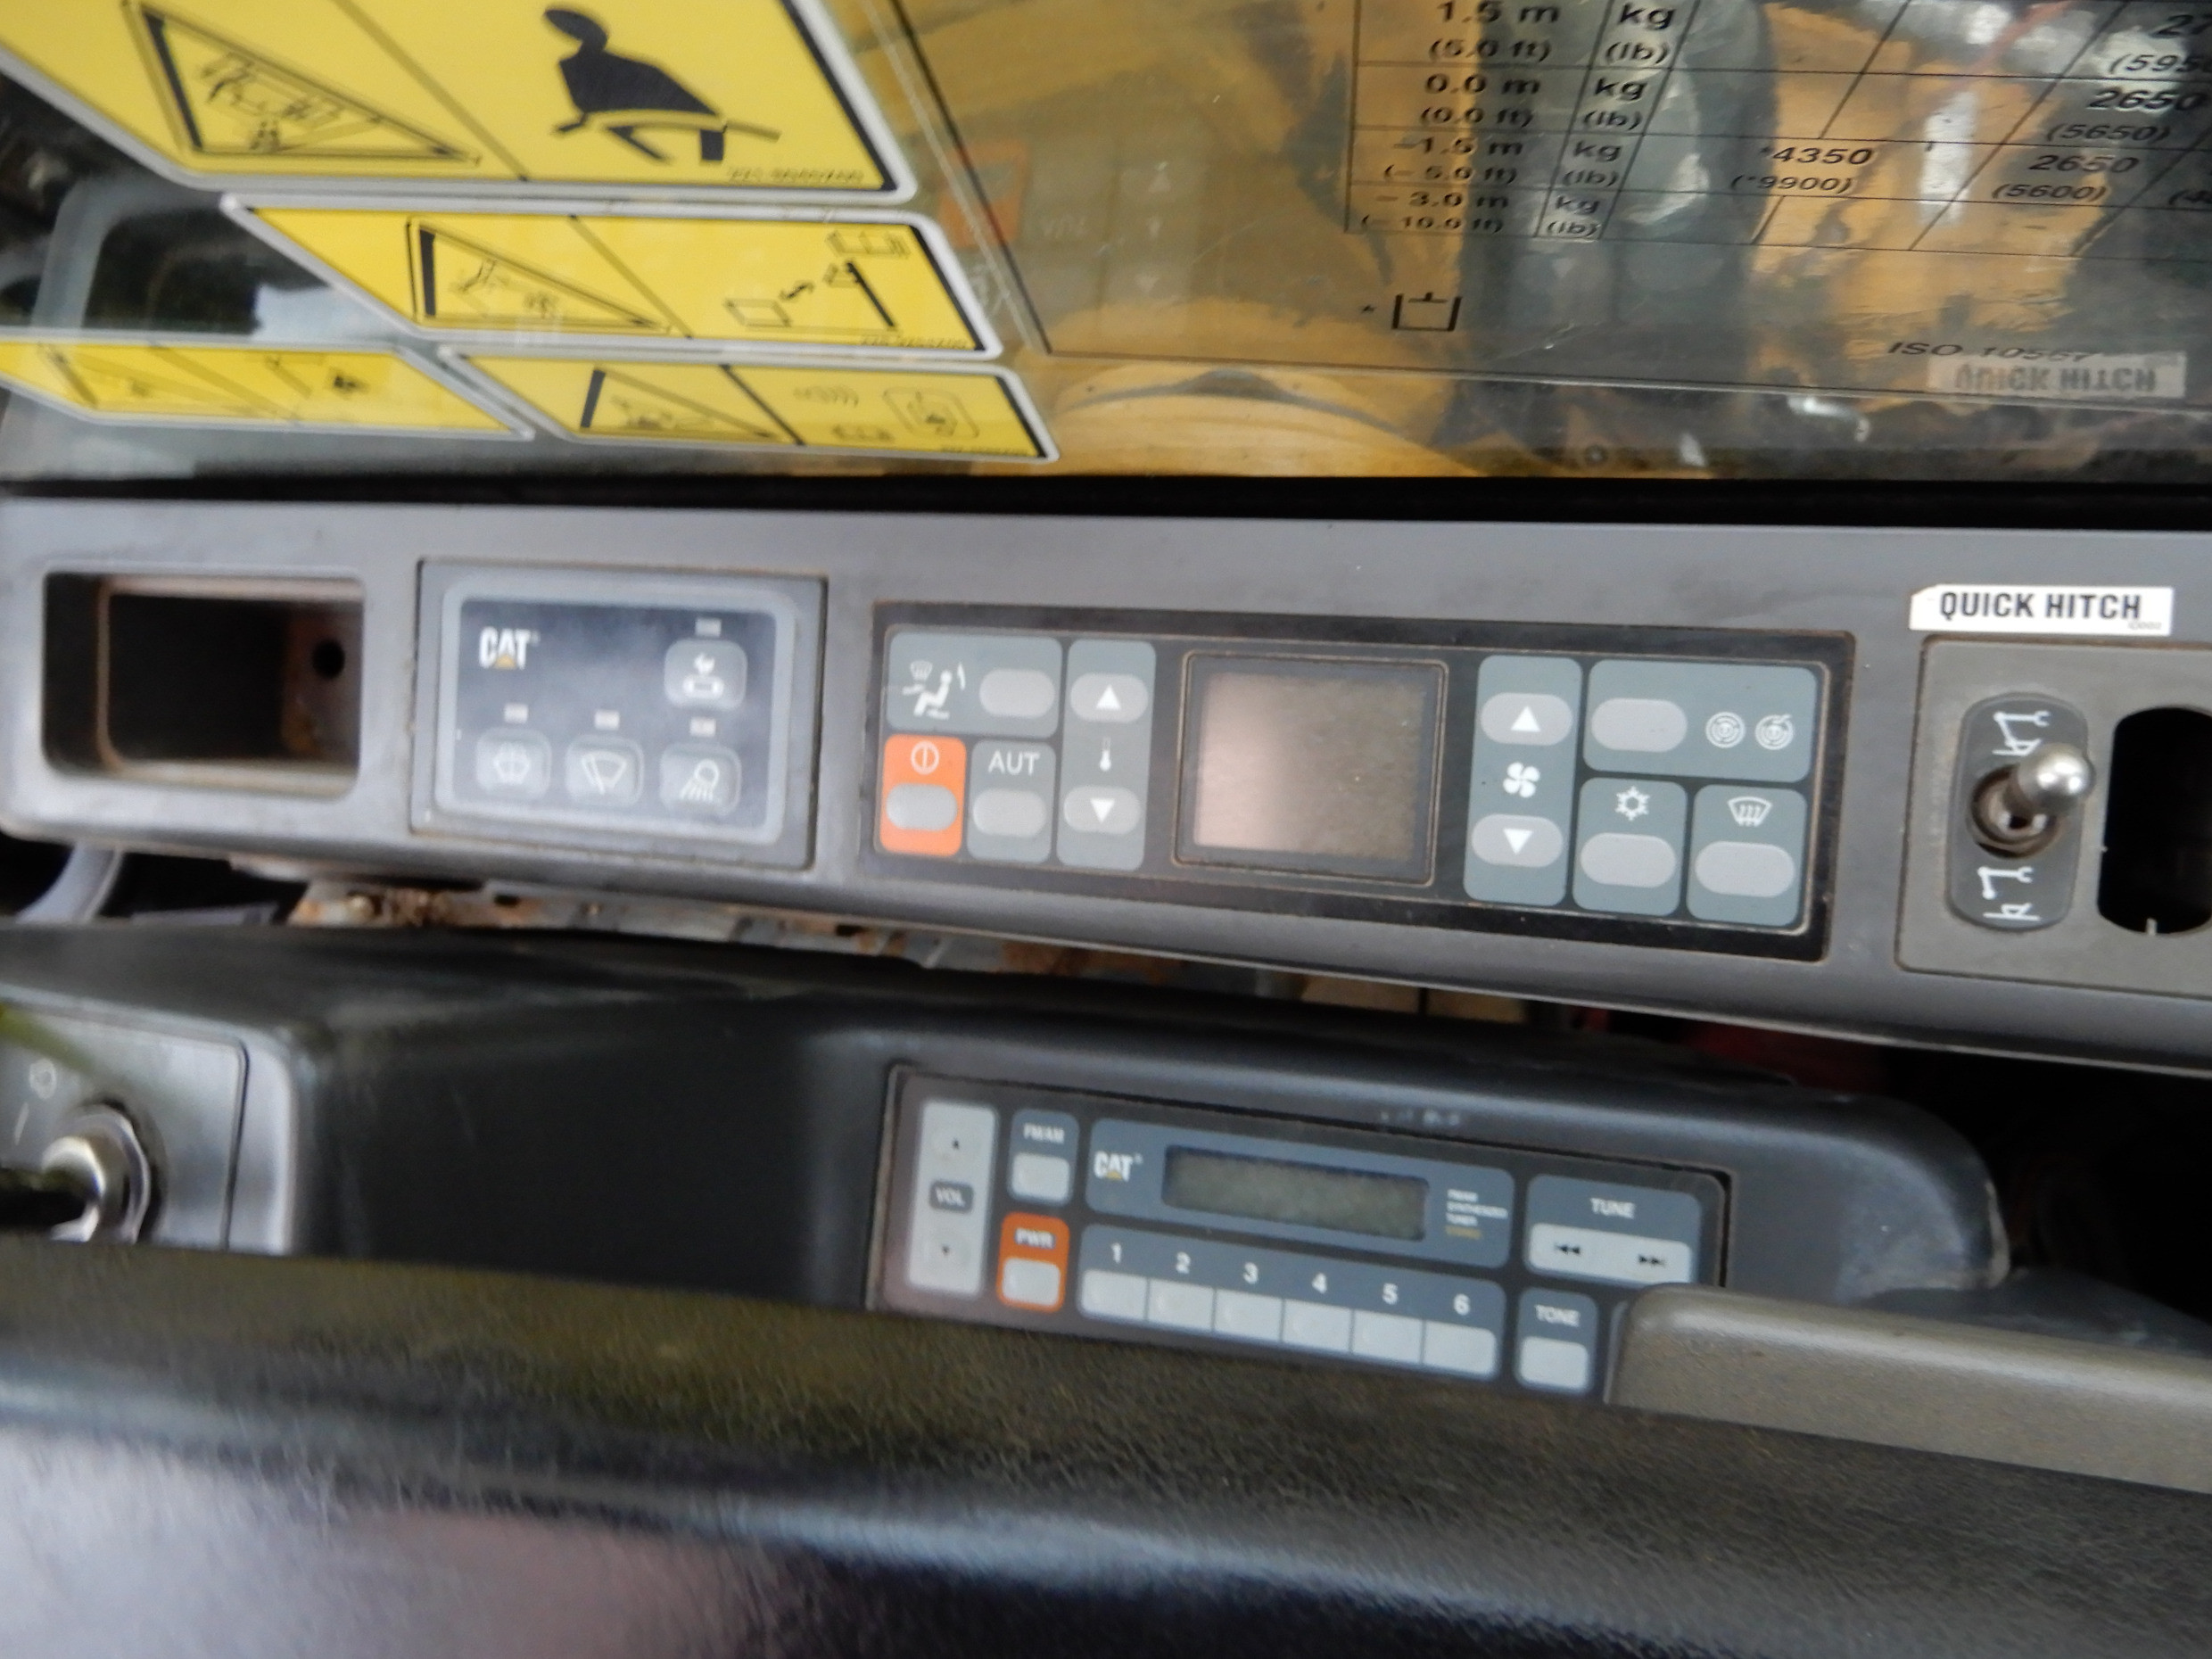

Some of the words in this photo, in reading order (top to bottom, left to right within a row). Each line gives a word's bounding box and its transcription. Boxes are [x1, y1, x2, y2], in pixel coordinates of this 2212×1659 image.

[1518, 5, 1561, 23] m
[1619, 3, 1676, 29] kg
[1605, 41, 1670, 64] (lb)
[1500, 78, 1542, 95] m
[1594, 77, 1648, 102] kg
[2088, 87, 2211, 111] 2650
[1582, 110, 1643, 132] (lb)
[2045, 122, 2172, 144] (5650)
[1489, 141, 1524, 156] m
[1573, 140, 1623, 163] kg
[2027, 153, 2140, 175] 2650
[1564, 169, 1620, 187] (lb)
[1476, 194, 1510, 209] m
[1992, 181, 2109, 203] (5600)
[1555, 194, 1600, 216] kg
[1887, 341, 1963, 357] ISO
[1939, 590, 2035, 622] QUICK
[2045, 593, 2142, 620] HITCH
[478, 625, 532, 671] CAT
[987, 750, 1041, 776] AUT
[1094, 1150, 1134, 1183] CAT
[935, 1186, 967, 1209] VOL
[1589, 1196, 1636, 1221] TUNE
[1013, 1226, 1055, 1250] PWR
[1110, 1242, 1122, 1264] 1
[1175, 1251, 1192, 1275] 2
[1242, 1261, 1259, 1284] 3
[1311, 1272, 1328, 1294] 4
[1382, 1283, 1399, 1306] 5
[1453, 1292, 1471, 1316] 6
[1534, 1302, 1581, 1328] TONE
